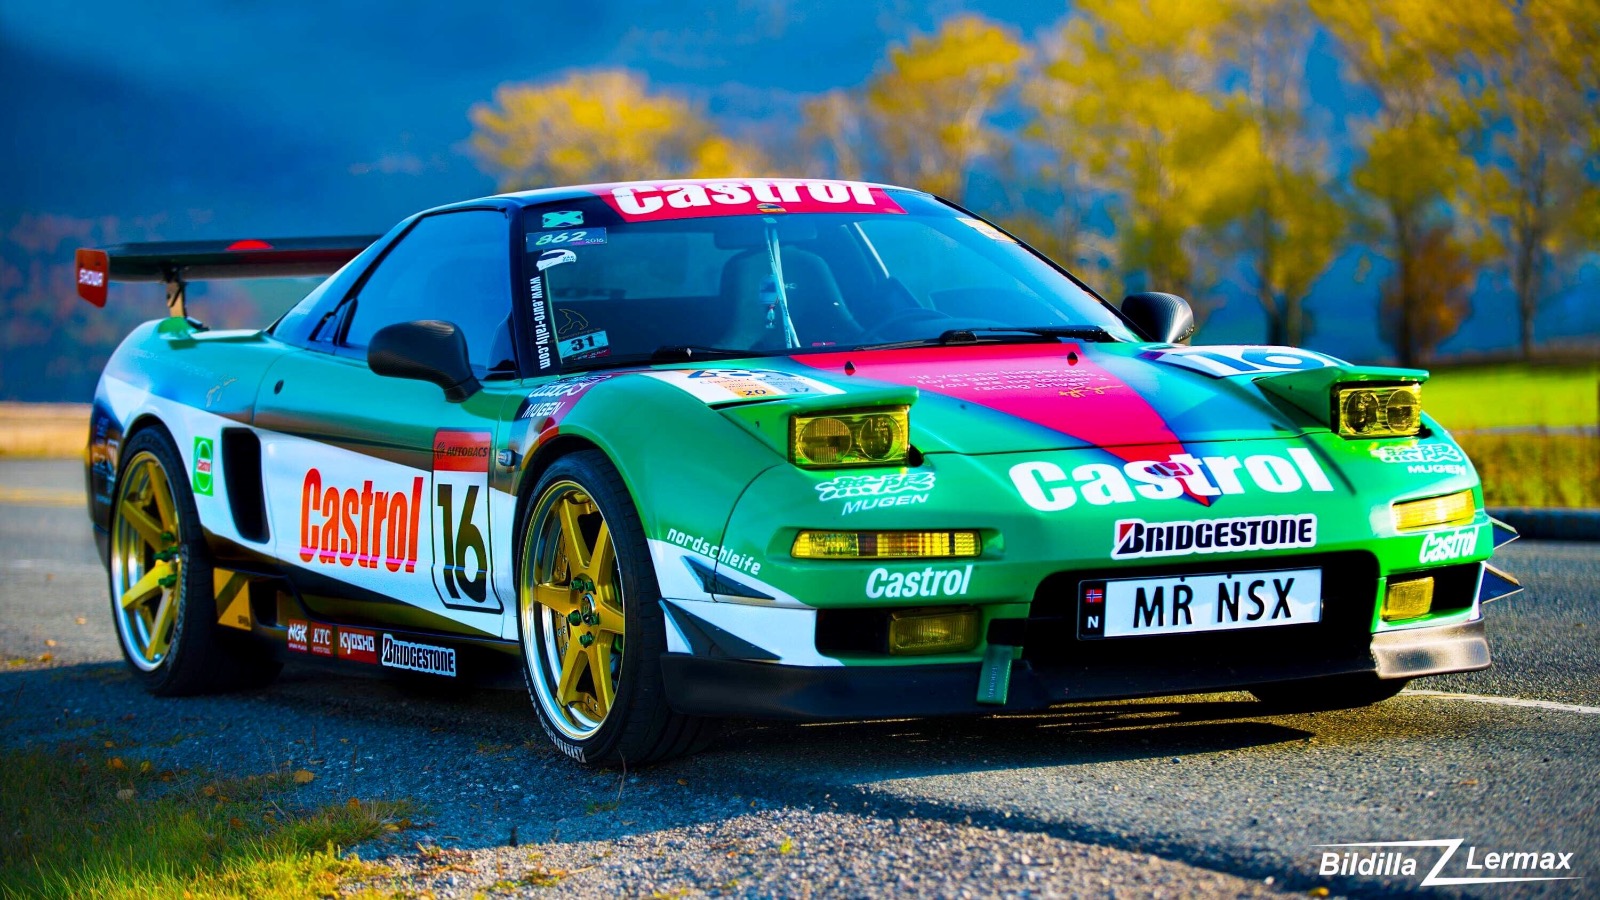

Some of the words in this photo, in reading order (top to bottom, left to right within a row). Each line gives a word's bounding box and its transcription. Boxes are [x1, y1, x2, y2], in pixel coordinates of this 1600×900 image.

[610, 181, 877, 215] Castrol
[529, 276, 552, 370] www.euro-rally.com
[570, 335, 595, 351] 31
[521, 401, 566, 419] MUGEN
[446, 446, 488, 458] AUTOBACS
[1407, 464, 1466, 476] MUGEN
[1009, 447, 1335, 513] Castrol
[299, 467, 424, 574] Castrol
[841, 493, 930, 516] MUGEN
[437, 483, 488, 604] 16
[666, 527, 762, 576] nordschleife
[1117, 517, 1313, 555] BRIDGESTONE
[1418, 525, 1480, 564] Castrol
[864, 564, 975, 600] Castrol
[1132, 583, 1195, 629] MR
[1216, 576, 1296, 624] NSX
[288, 623, 308, 643] NGK
[1087, 615, 1099, 629] N
[383, 634, 456, 675] BRIDGESTONE
